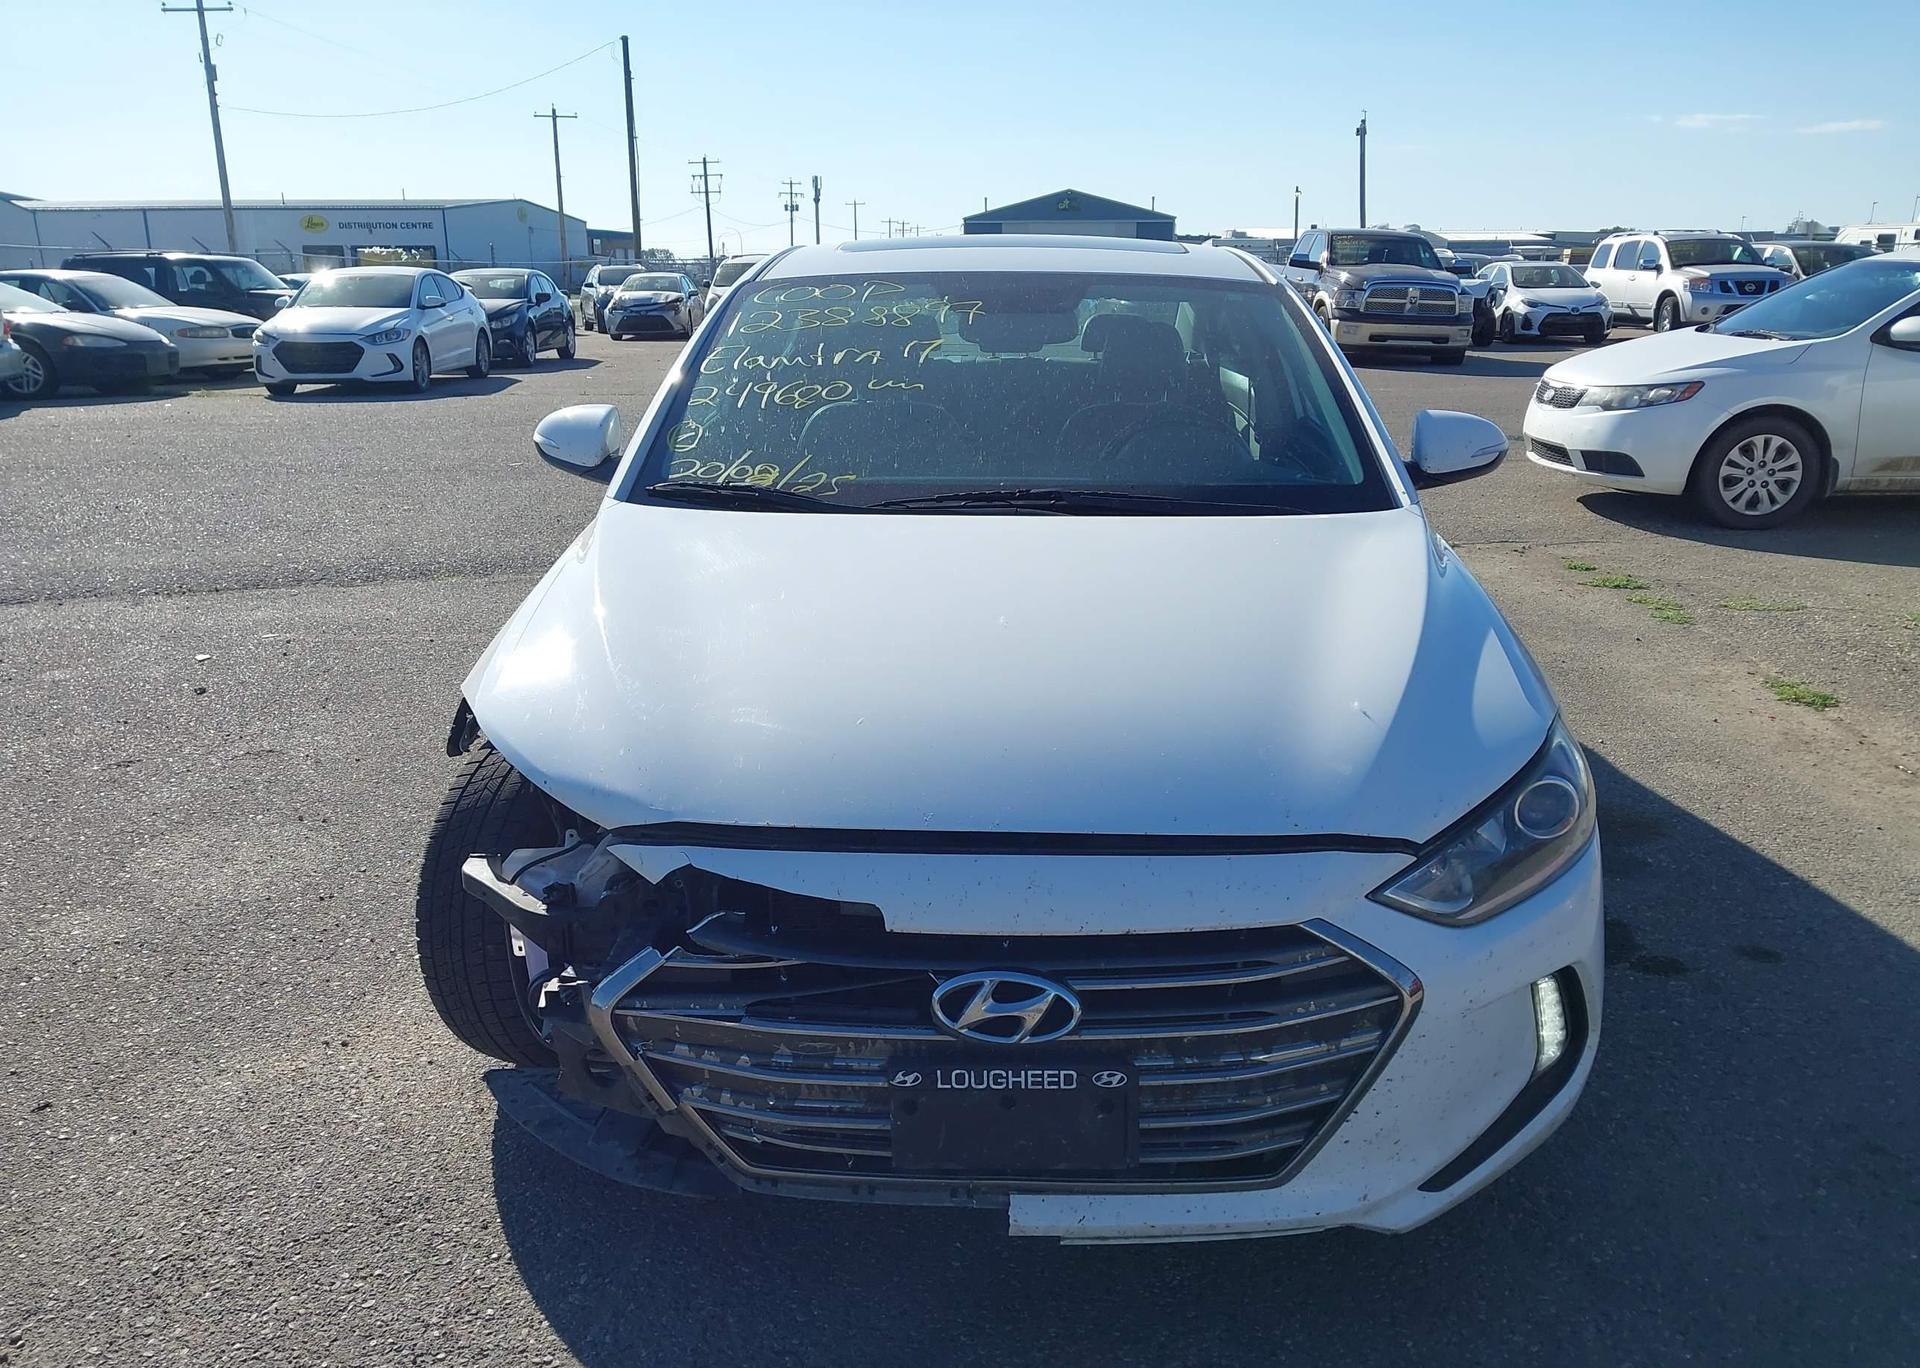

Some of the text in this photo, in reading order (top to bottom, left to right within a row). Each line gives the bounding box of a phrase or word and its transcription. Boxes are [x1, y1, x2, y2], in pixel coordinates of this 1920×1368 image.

[338, 221, 433, 230] DISTRIBUTION CENTRE
[936, 1069, 1078, 1090] LOUGHEED
